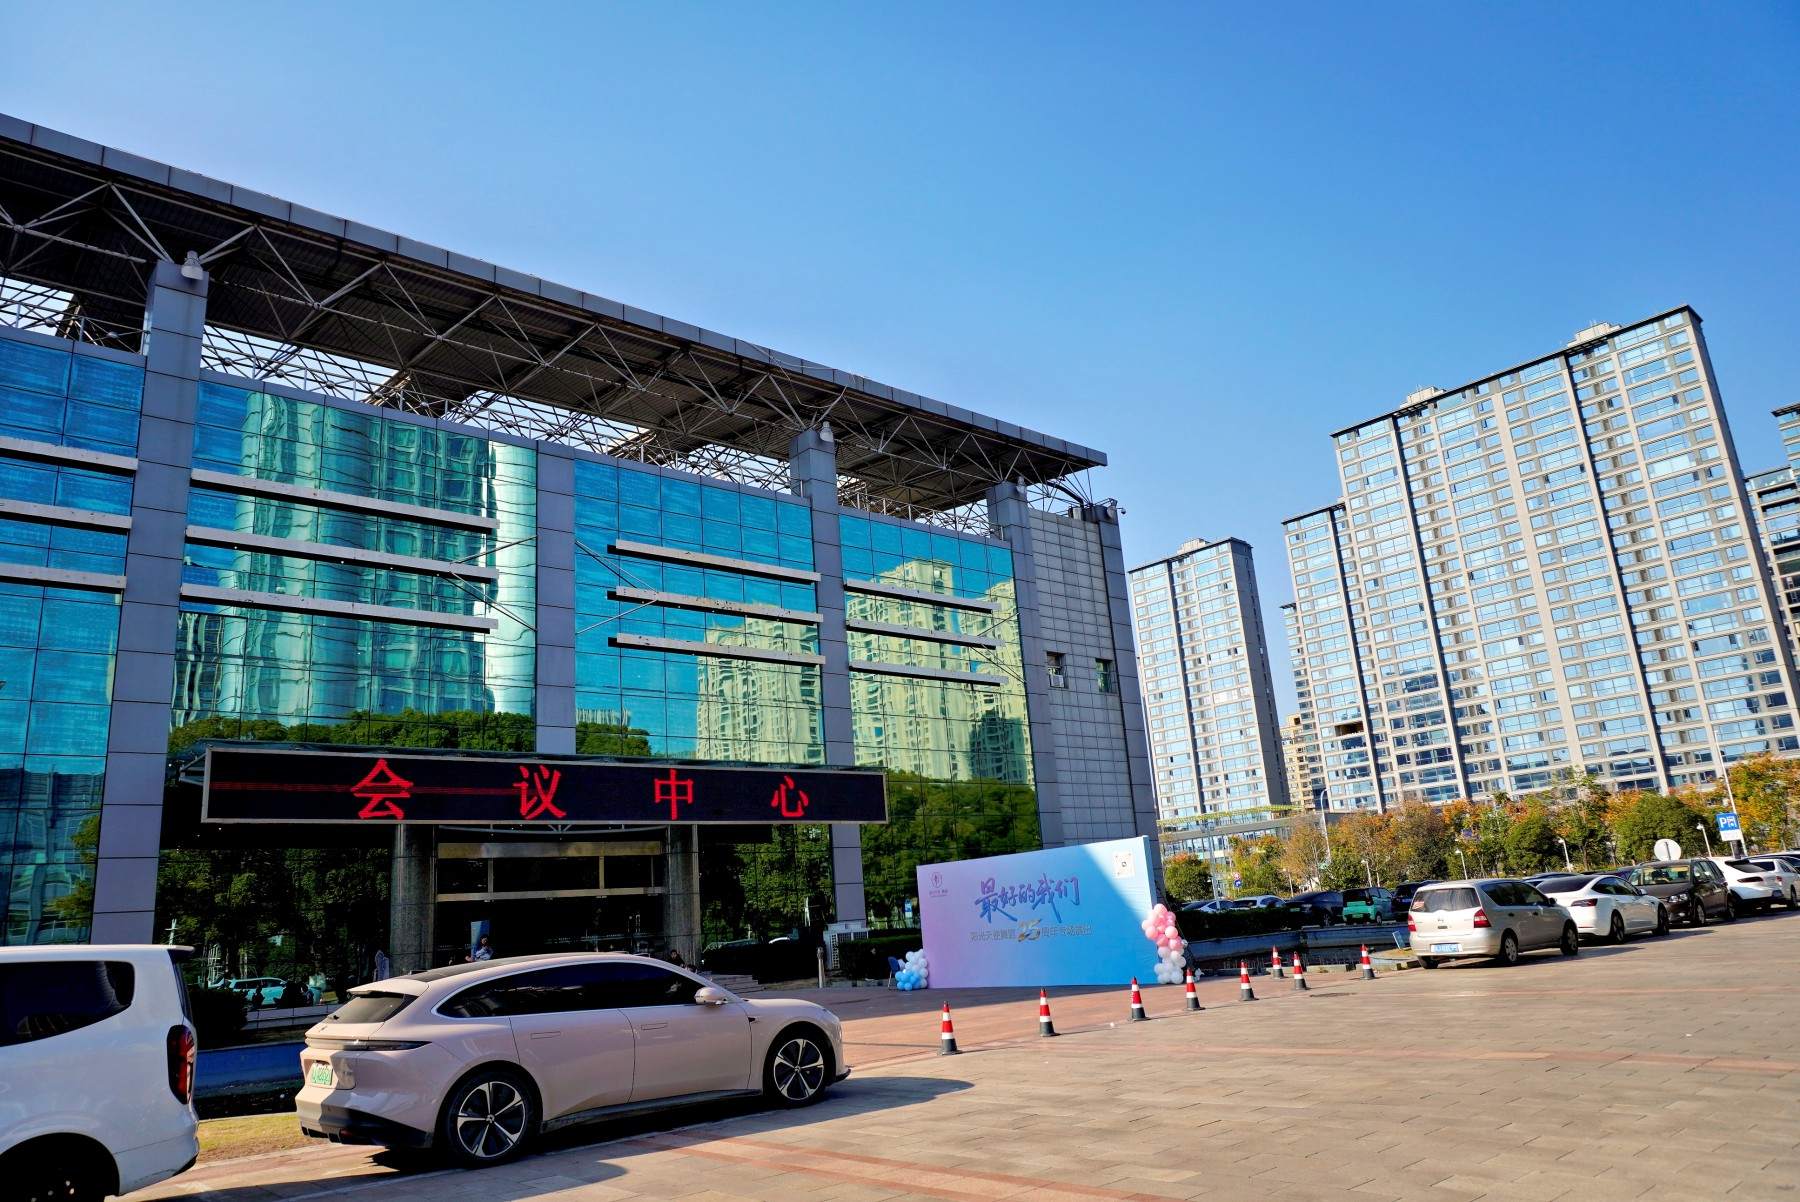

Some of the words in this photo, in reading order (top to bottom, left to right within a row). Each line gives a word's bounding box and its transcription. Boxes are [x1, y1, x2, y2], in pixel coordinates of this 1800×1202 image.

[351, 759, 809, 821] 会议中心
[974, 872, 1081, 924] 最好的我们
